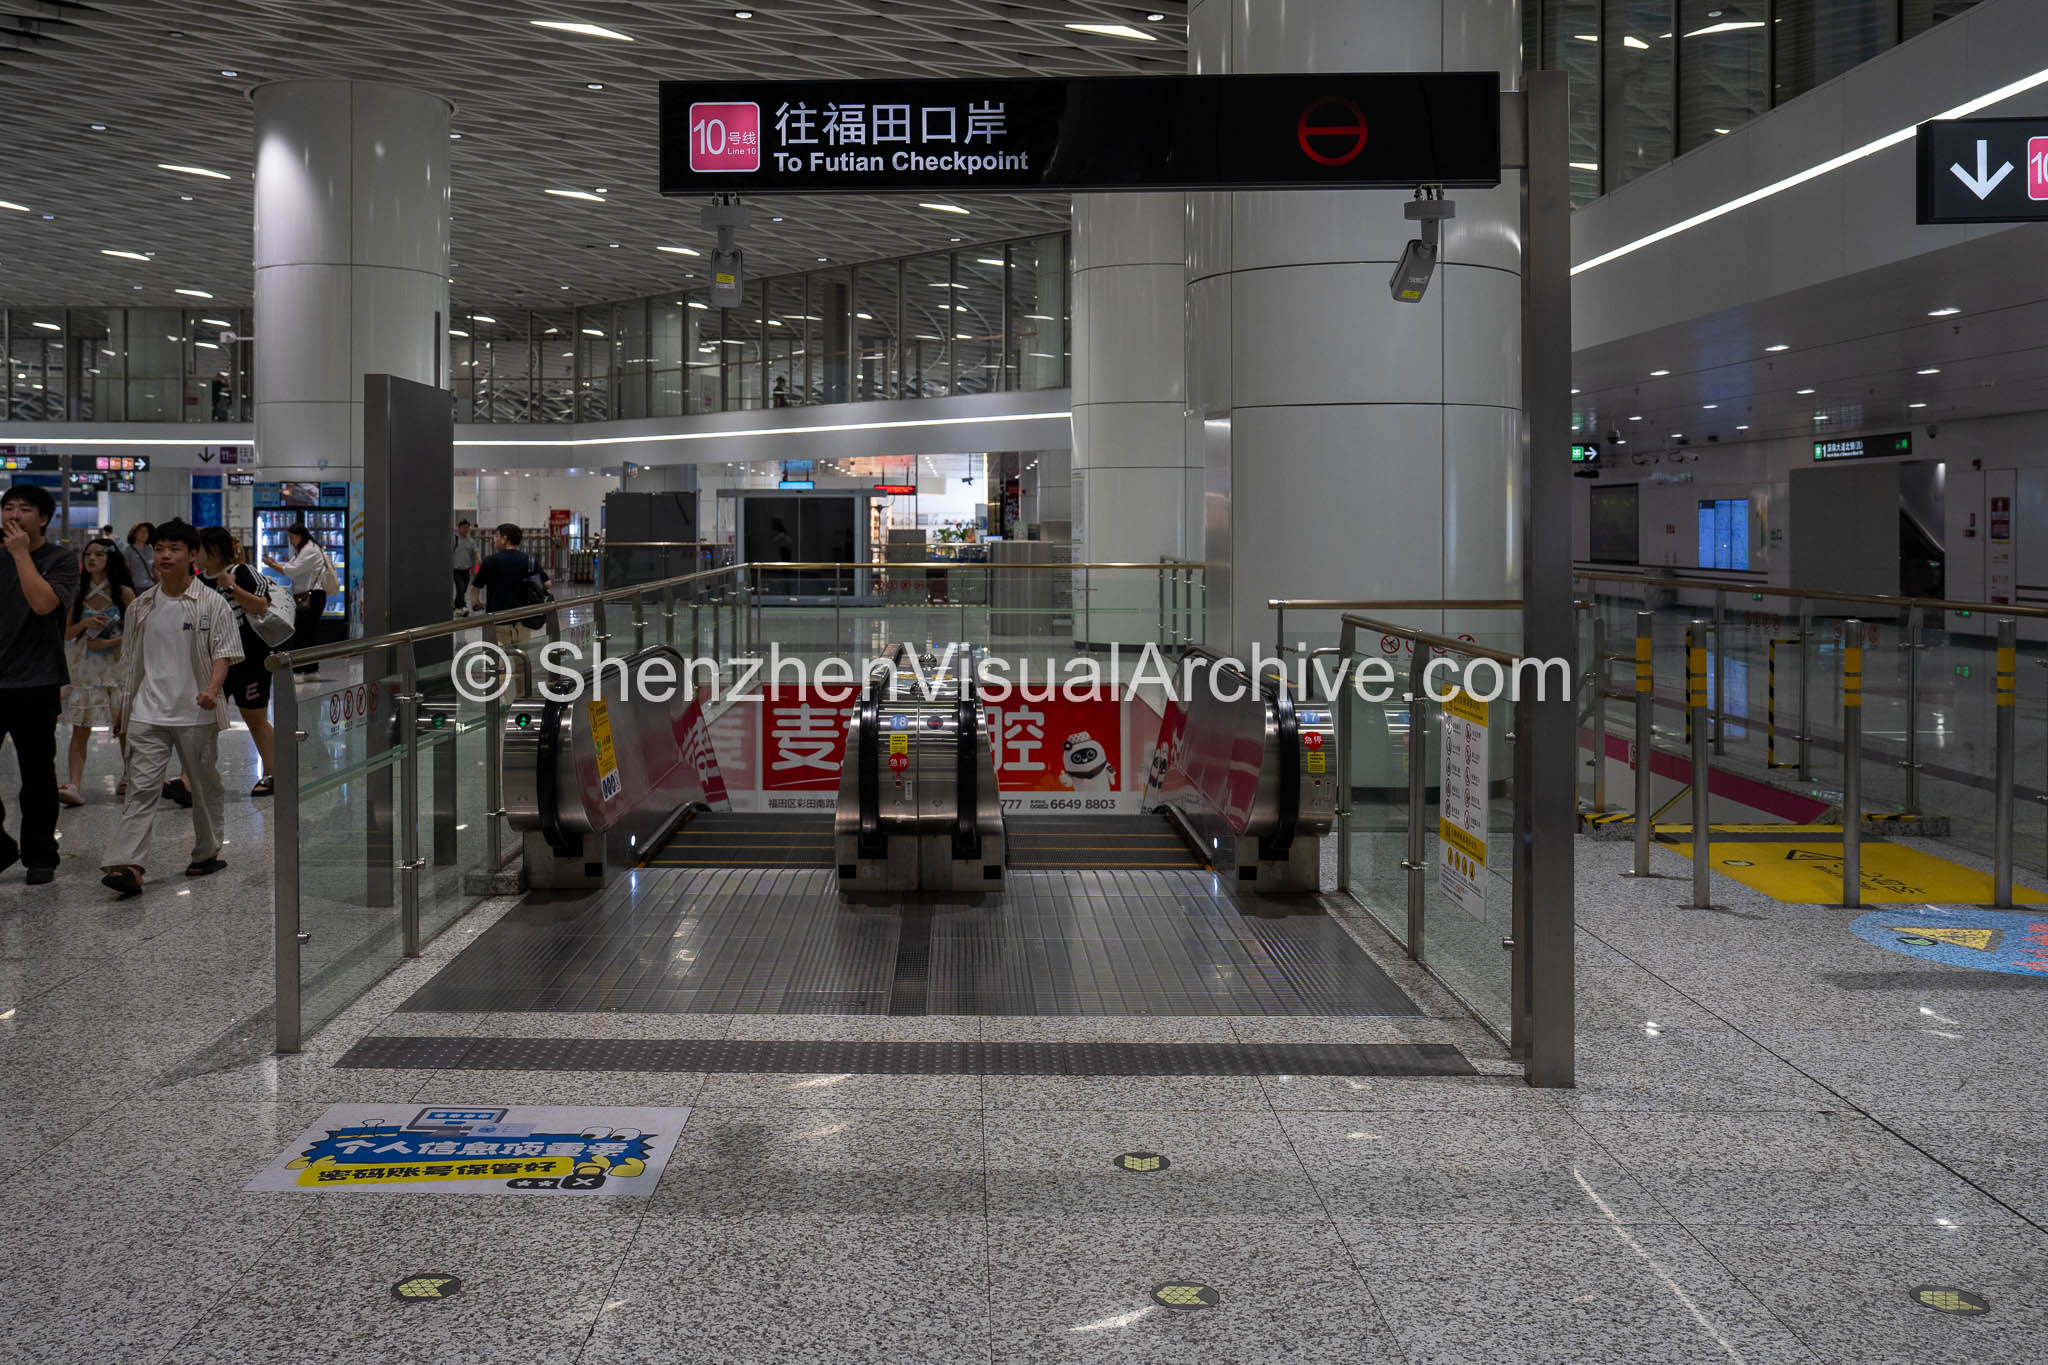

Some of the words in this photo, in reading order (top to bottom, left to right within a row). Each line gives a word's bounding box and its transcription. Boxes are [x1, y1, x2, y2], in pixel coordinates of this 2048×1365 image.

[775, 101, 1007, 146] 往福田口岸
[694, 119, 726, 155] 10
[774, 152, 802, 172] To
[810, 152, 884, 172] Futian
[892, 151, 1029, 175] Checkpoint
[892, 717, 907, 727] 18
[1303, 712, 1317, 722] 17
[771, 703, 854, 771] 麦
[1050, 800, 1082, 809] 6649
[1085, 800, 1116, 809] 8803
